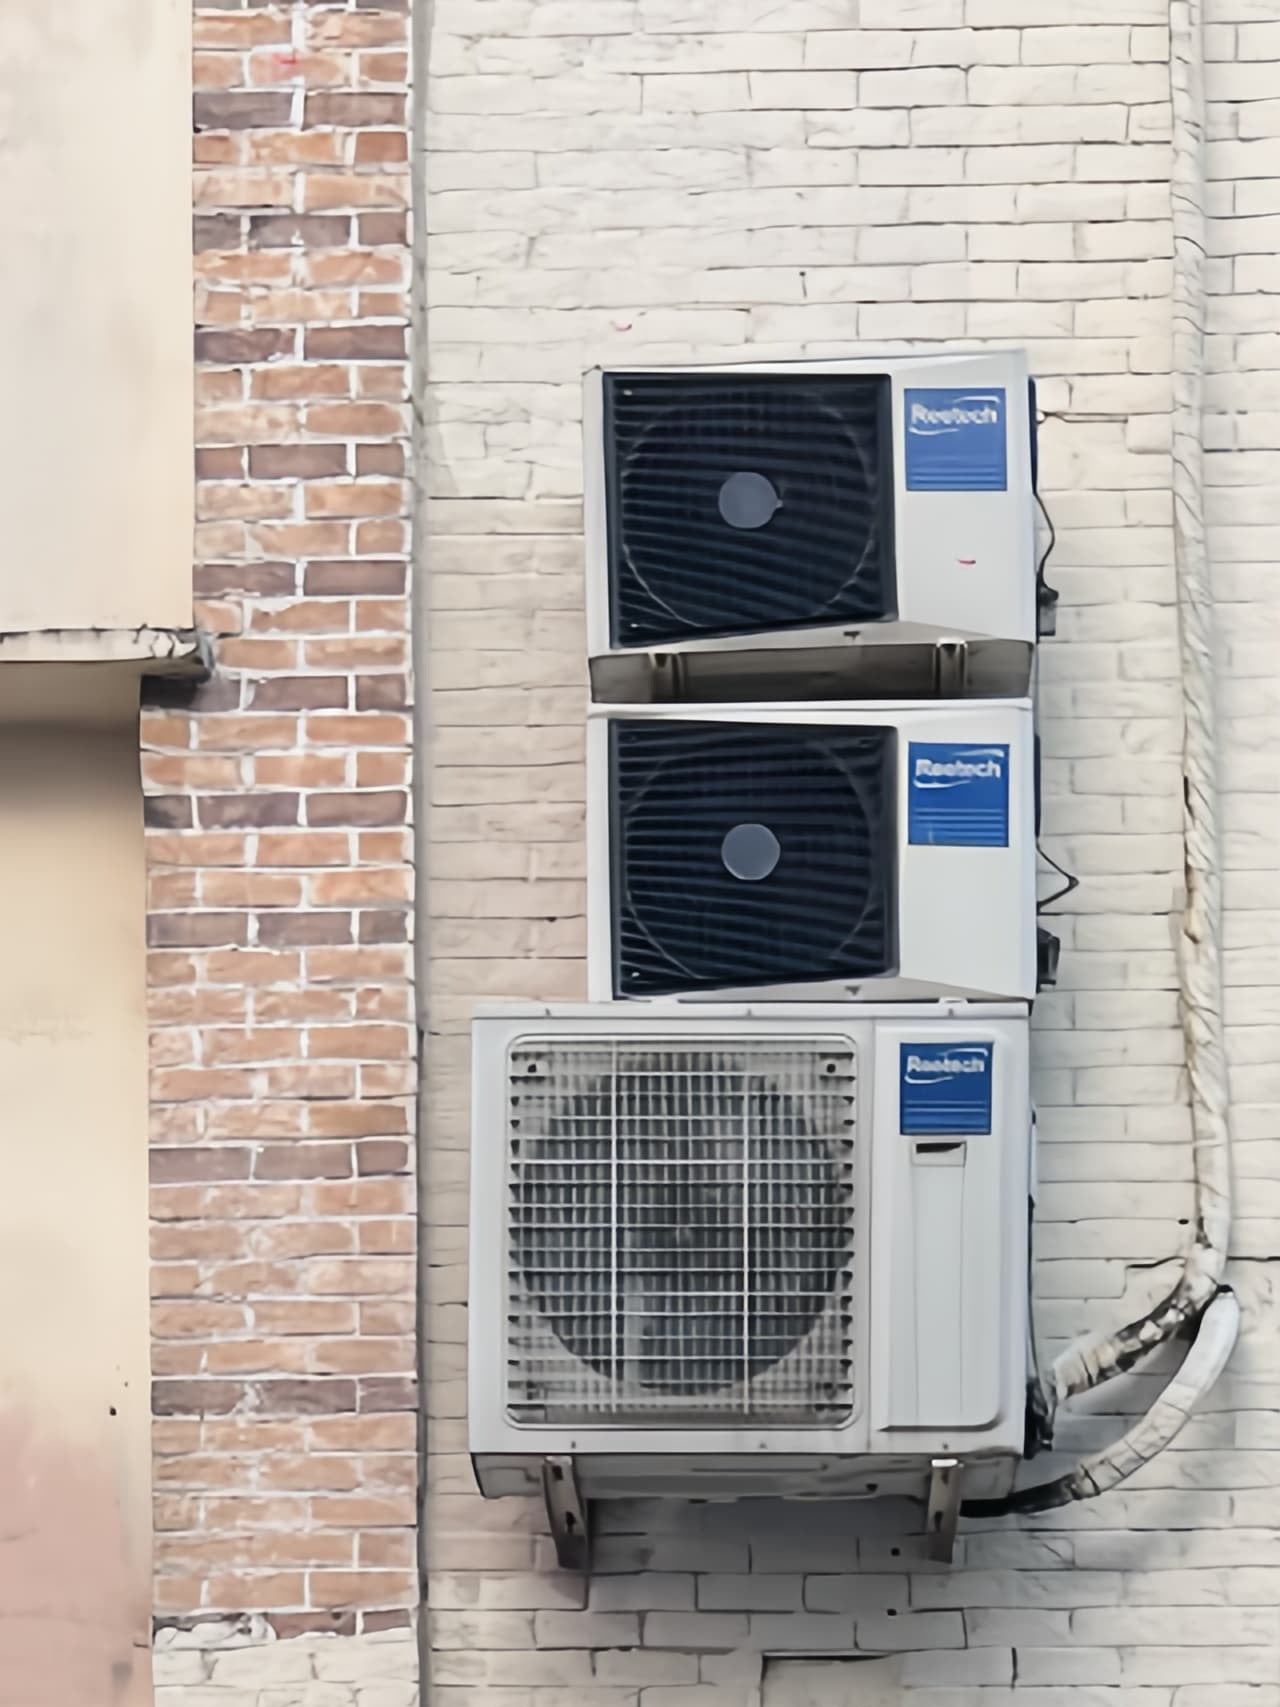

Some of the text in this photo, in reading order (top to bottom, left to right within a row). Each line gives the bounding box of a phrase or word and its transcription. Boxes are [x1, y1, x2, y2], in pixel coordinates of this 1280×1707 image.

[911, 403, 998, 424] Reetech
[915, 758, 1001, 778] Reetech
[907, 1055, 985, 1073] Reetech
